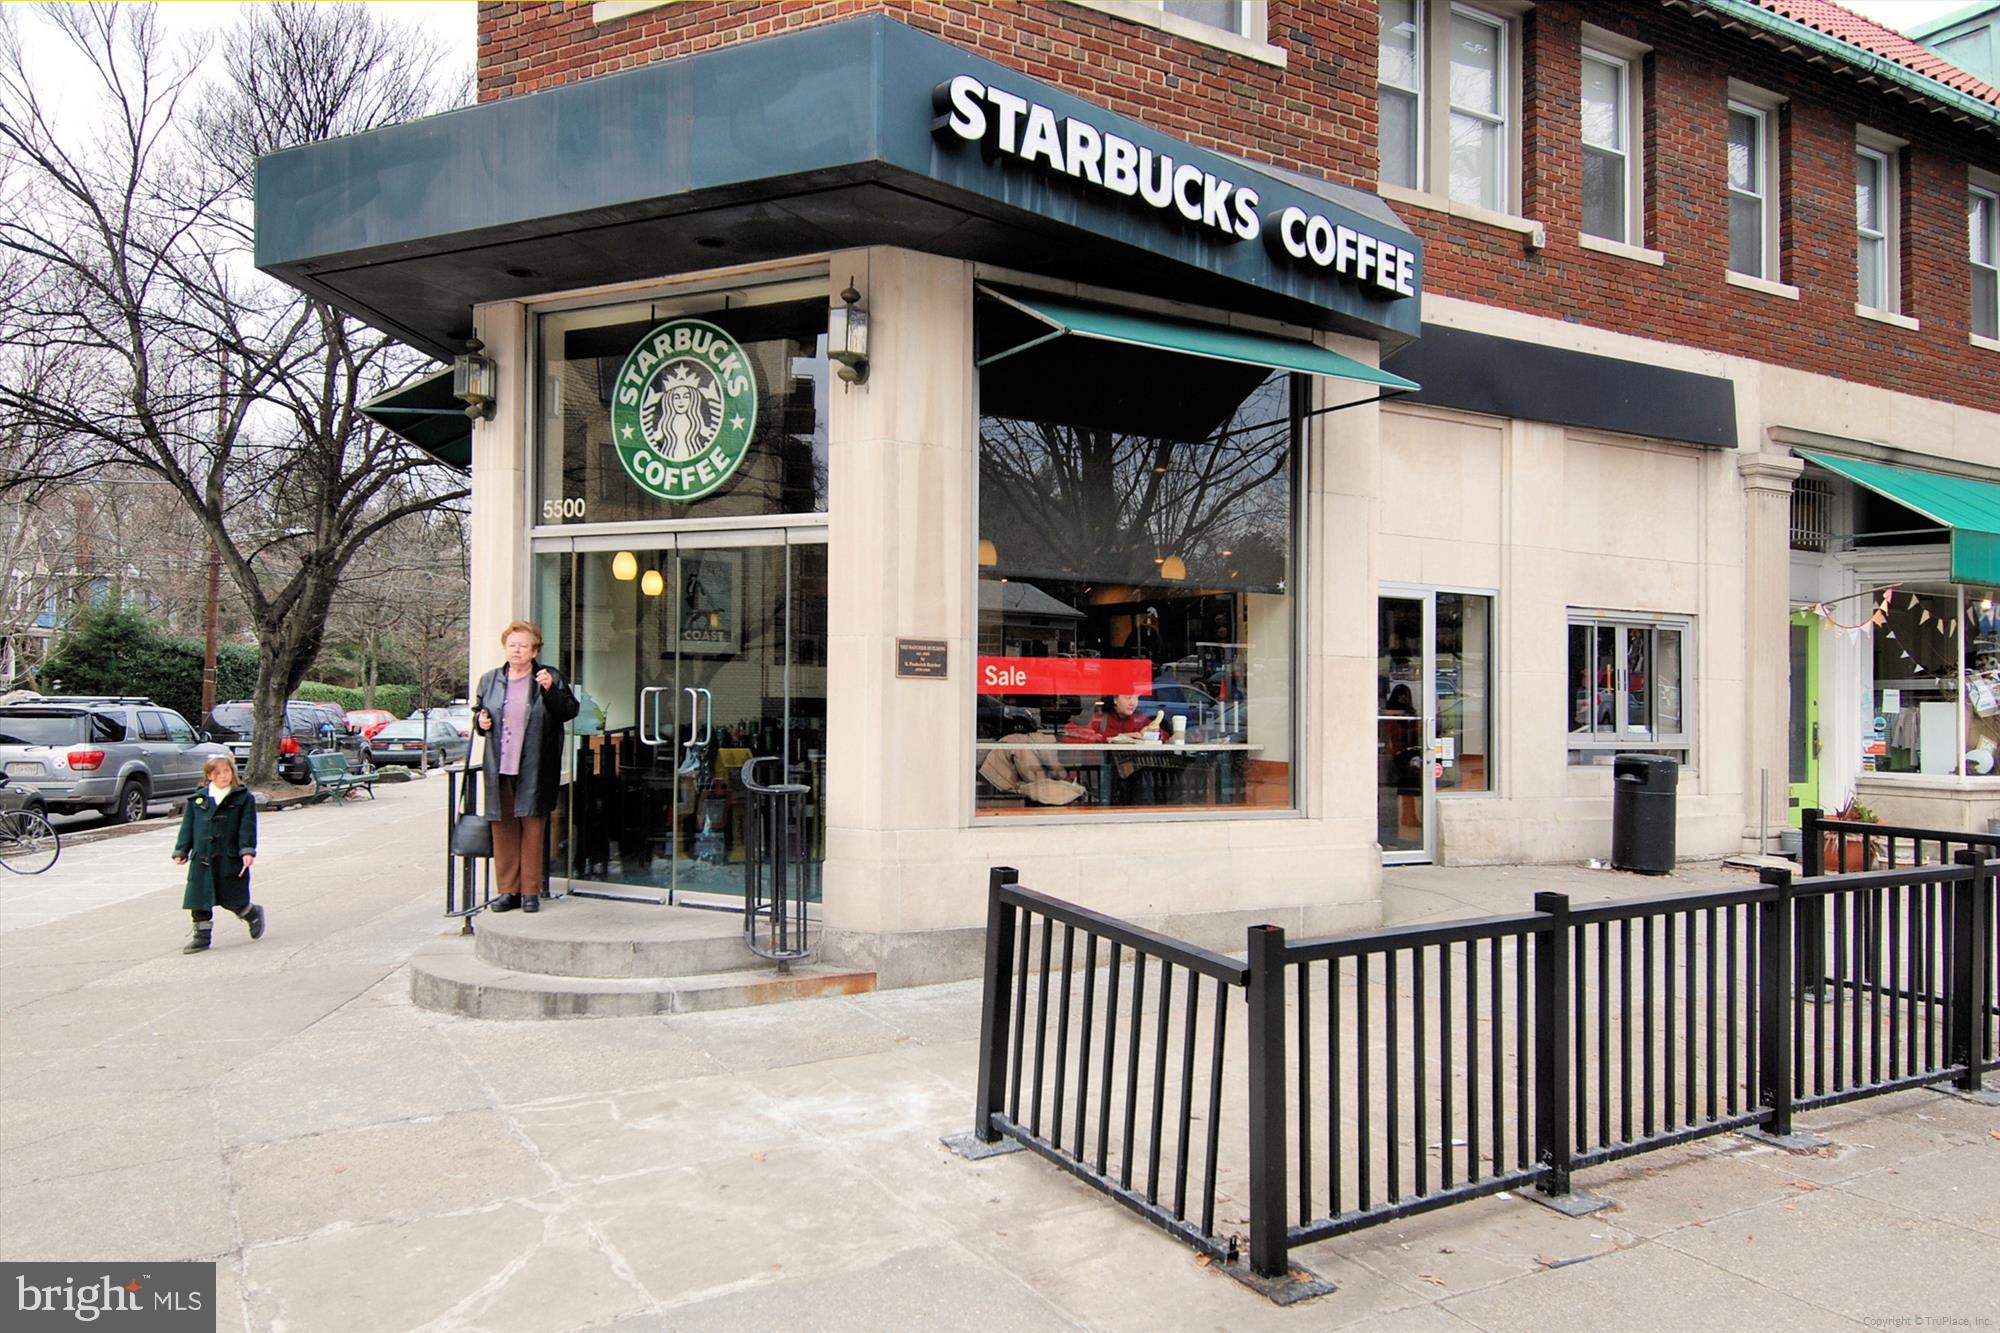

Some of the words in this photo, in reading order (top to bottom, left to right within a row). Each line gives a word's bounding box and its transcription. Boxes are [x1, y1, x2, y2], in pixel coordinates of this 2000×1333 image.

[948, 74, 1260, 241] STARBUCKS
[1280, 206, 1415, 297] COFFEE
[619, 328, 749, 407] STARBUCKS
[632, 446, 731, 491] COFFEE
[543, 498, 586, 519] 5500
[684, 630, 725, 641] COAST
[985, 665, 1027, 687] Sale
